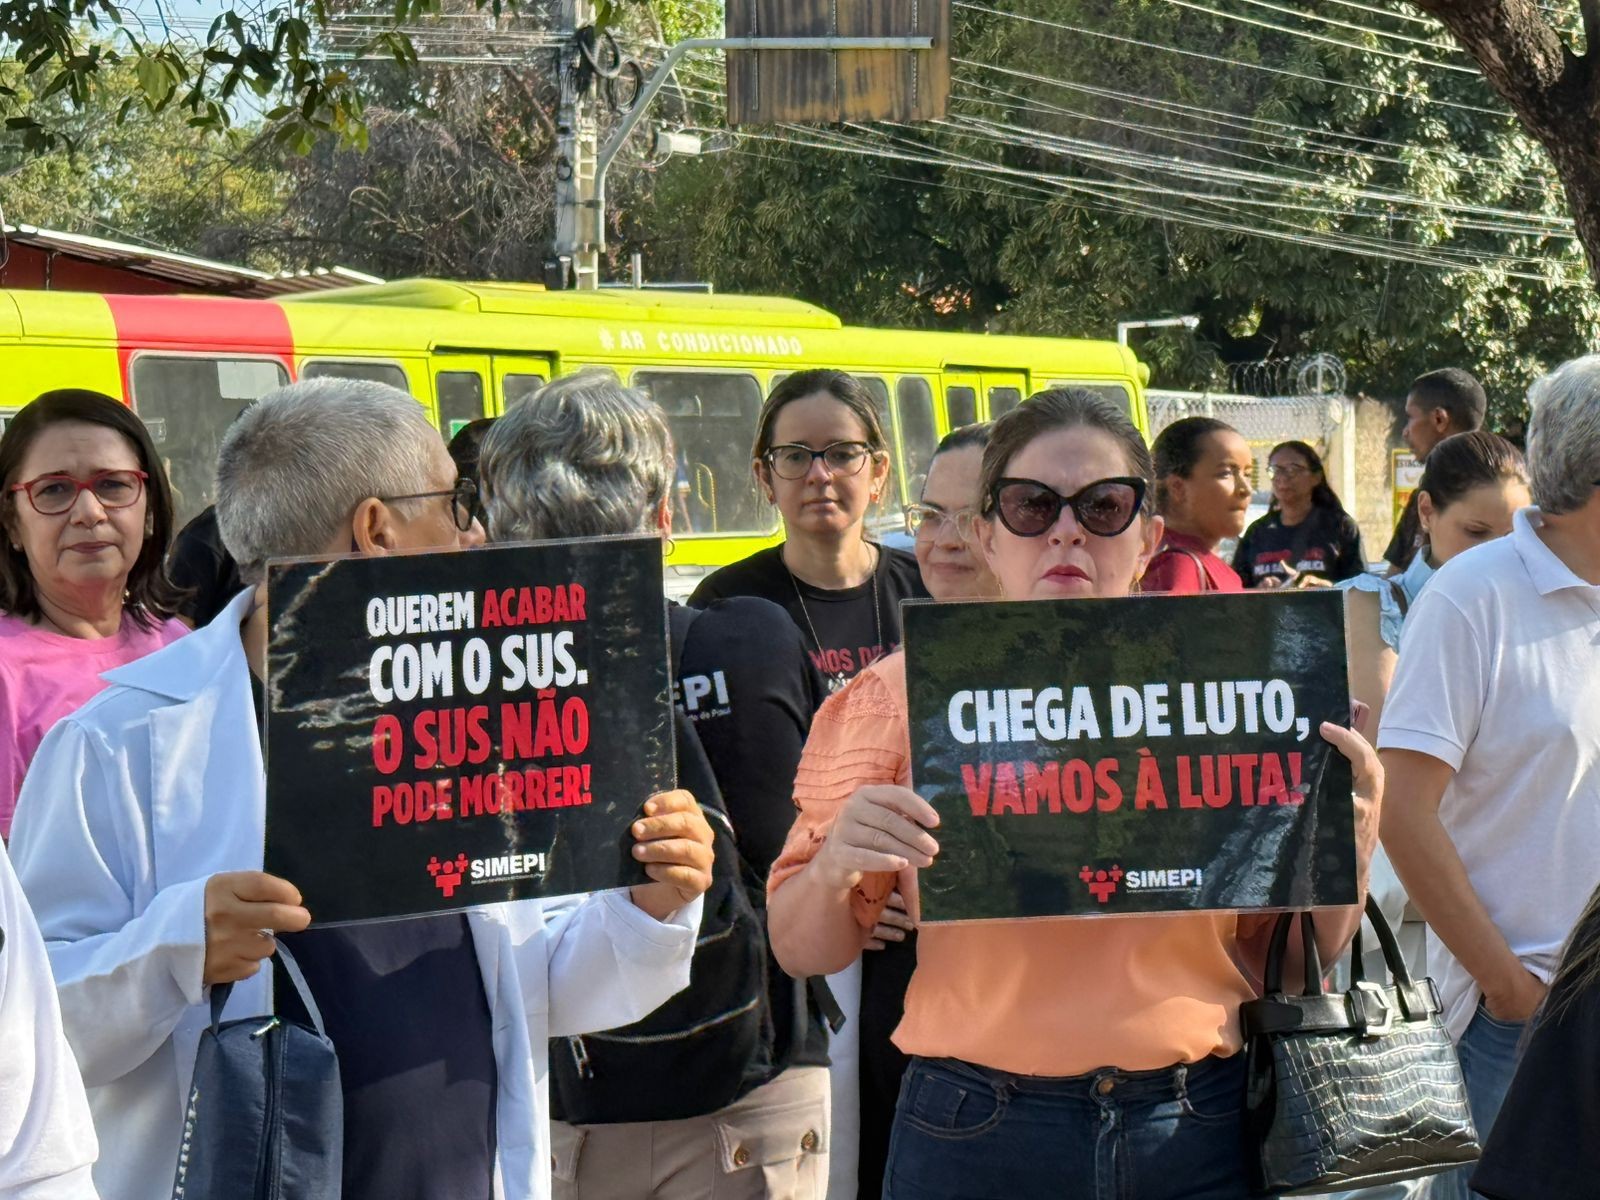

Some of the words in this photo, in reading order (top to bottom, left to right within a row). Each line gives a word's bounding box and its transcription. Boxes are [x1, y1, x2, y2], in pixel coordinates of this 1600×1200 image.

[620, 330, 645, 350] AR
[657, 331, 803, 355] CONDICIONADO
[366, 591, 475, 637] QUEREM
[481, 583, 587, 628] ACABAR
[369, 641, 454, 703] COM
[462, 637, 491, 695] O
[501, 631, 588, 692] SUS.
[372, 714, 403, 774] O
[413, 705, 491, 770] SUS
[501, 688, 589, 760] NÃO
[948, 685, 1101, 744] CHEGA
[1110, 683, 1171, 738] DE
[1181, 678, 1310, 742] LUTO,
[372, 778, 453, 827] PODE
[460, 764, 592, 817] MORRER!
[960, 758, 1123, 816] VAMOS
[1135, 746, 1168, 810] À
[1176, 751, 1304, 808] LUTA!
[470, 852, 545, 878] SIMEPI
[1125, 868, 1203, 889] SIMEPI
